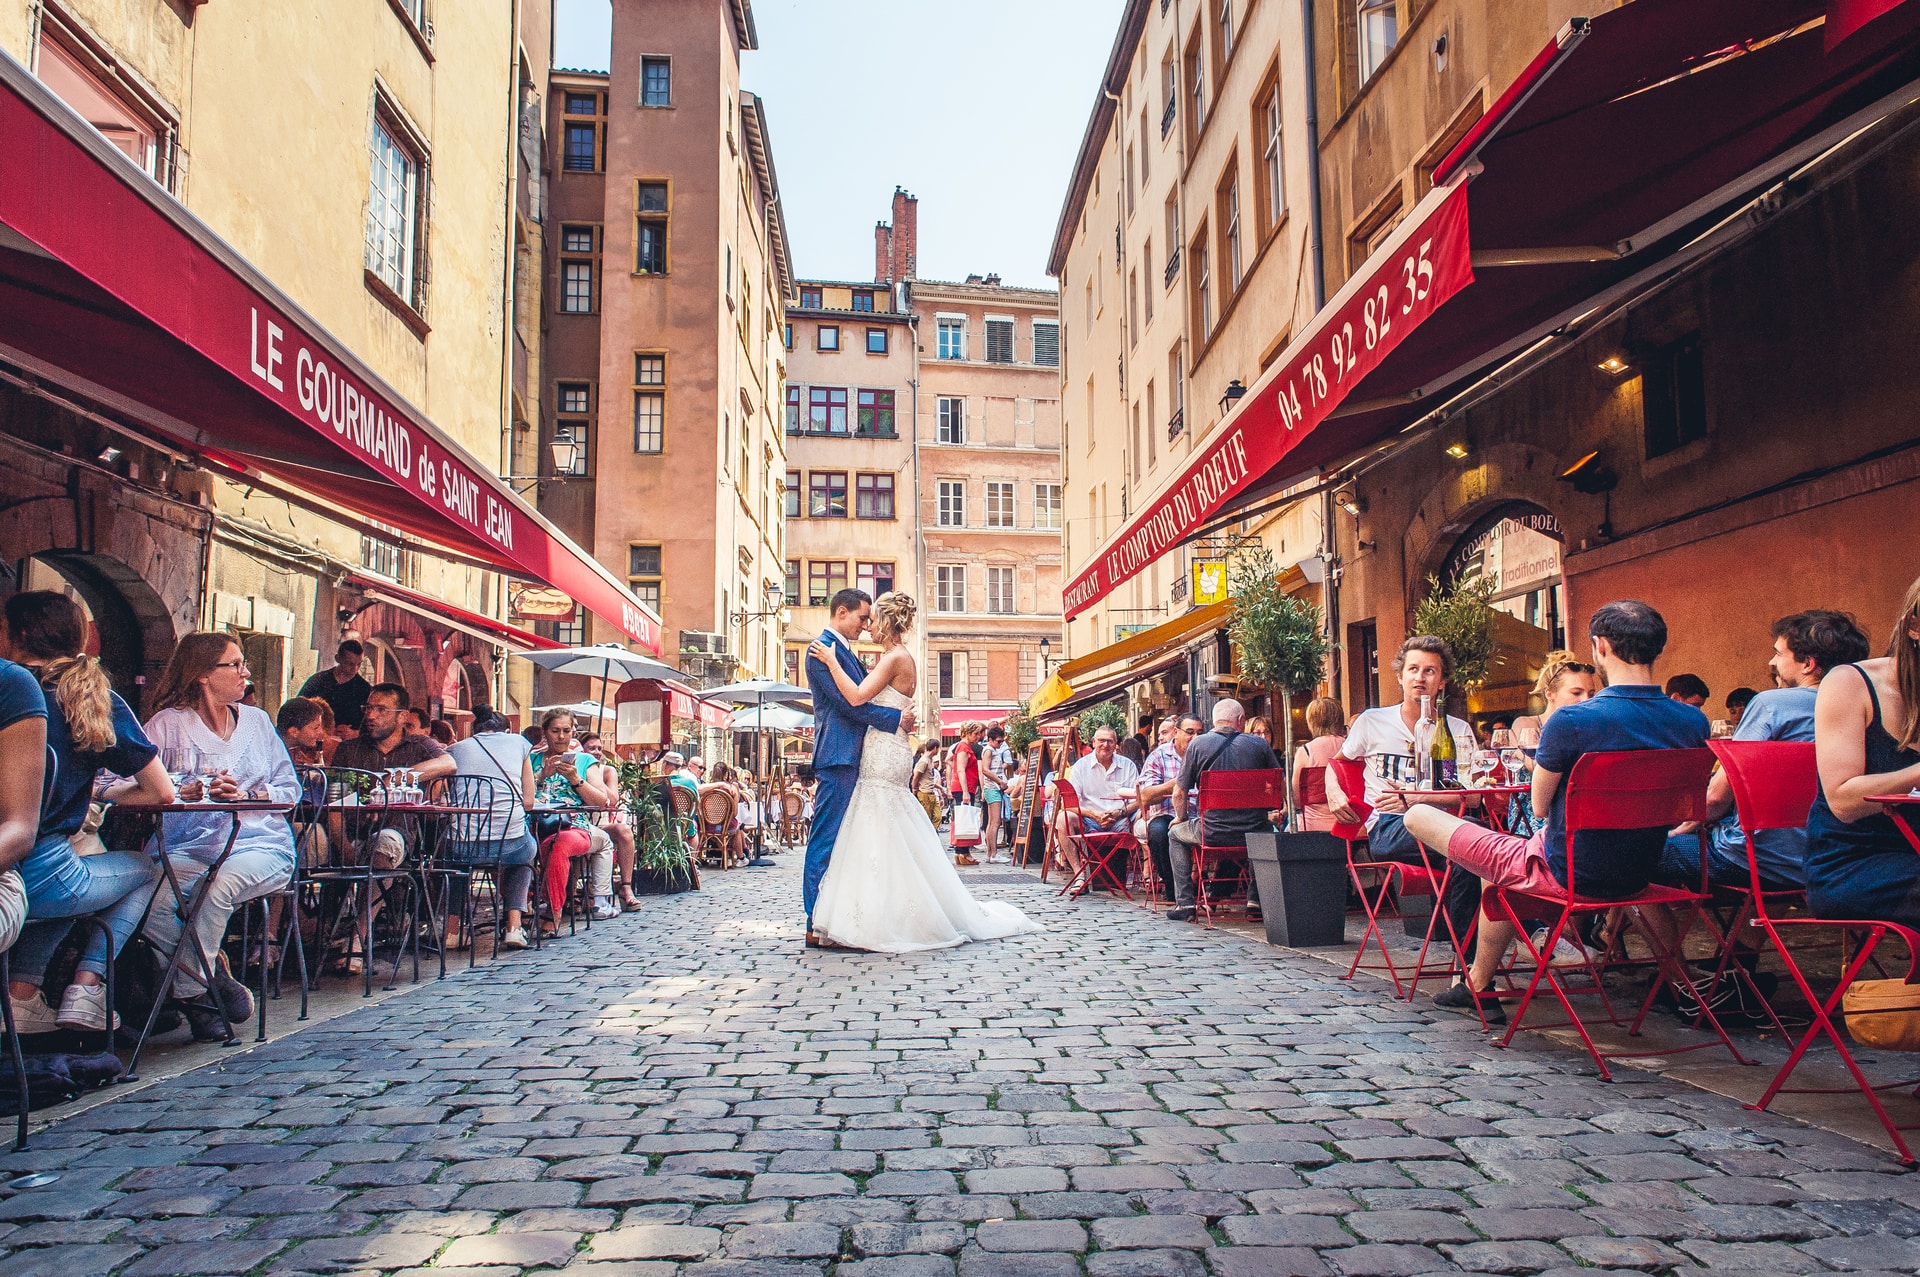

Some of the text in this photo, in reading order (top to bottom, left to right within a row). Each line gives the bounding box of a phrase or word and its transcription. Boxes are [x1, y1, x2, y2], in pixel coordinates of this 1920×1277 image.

[250, 306, 514, 551] LE GOURMAND de SAINT JEAN
[1064, 237, 1433, 612] RESTAURANT LE COMPTOIR DU BOEUF 04 78 92 82 35
[1514, 515, 1530, 533] DU
[1531, 514, 1564, 534] BOEU
